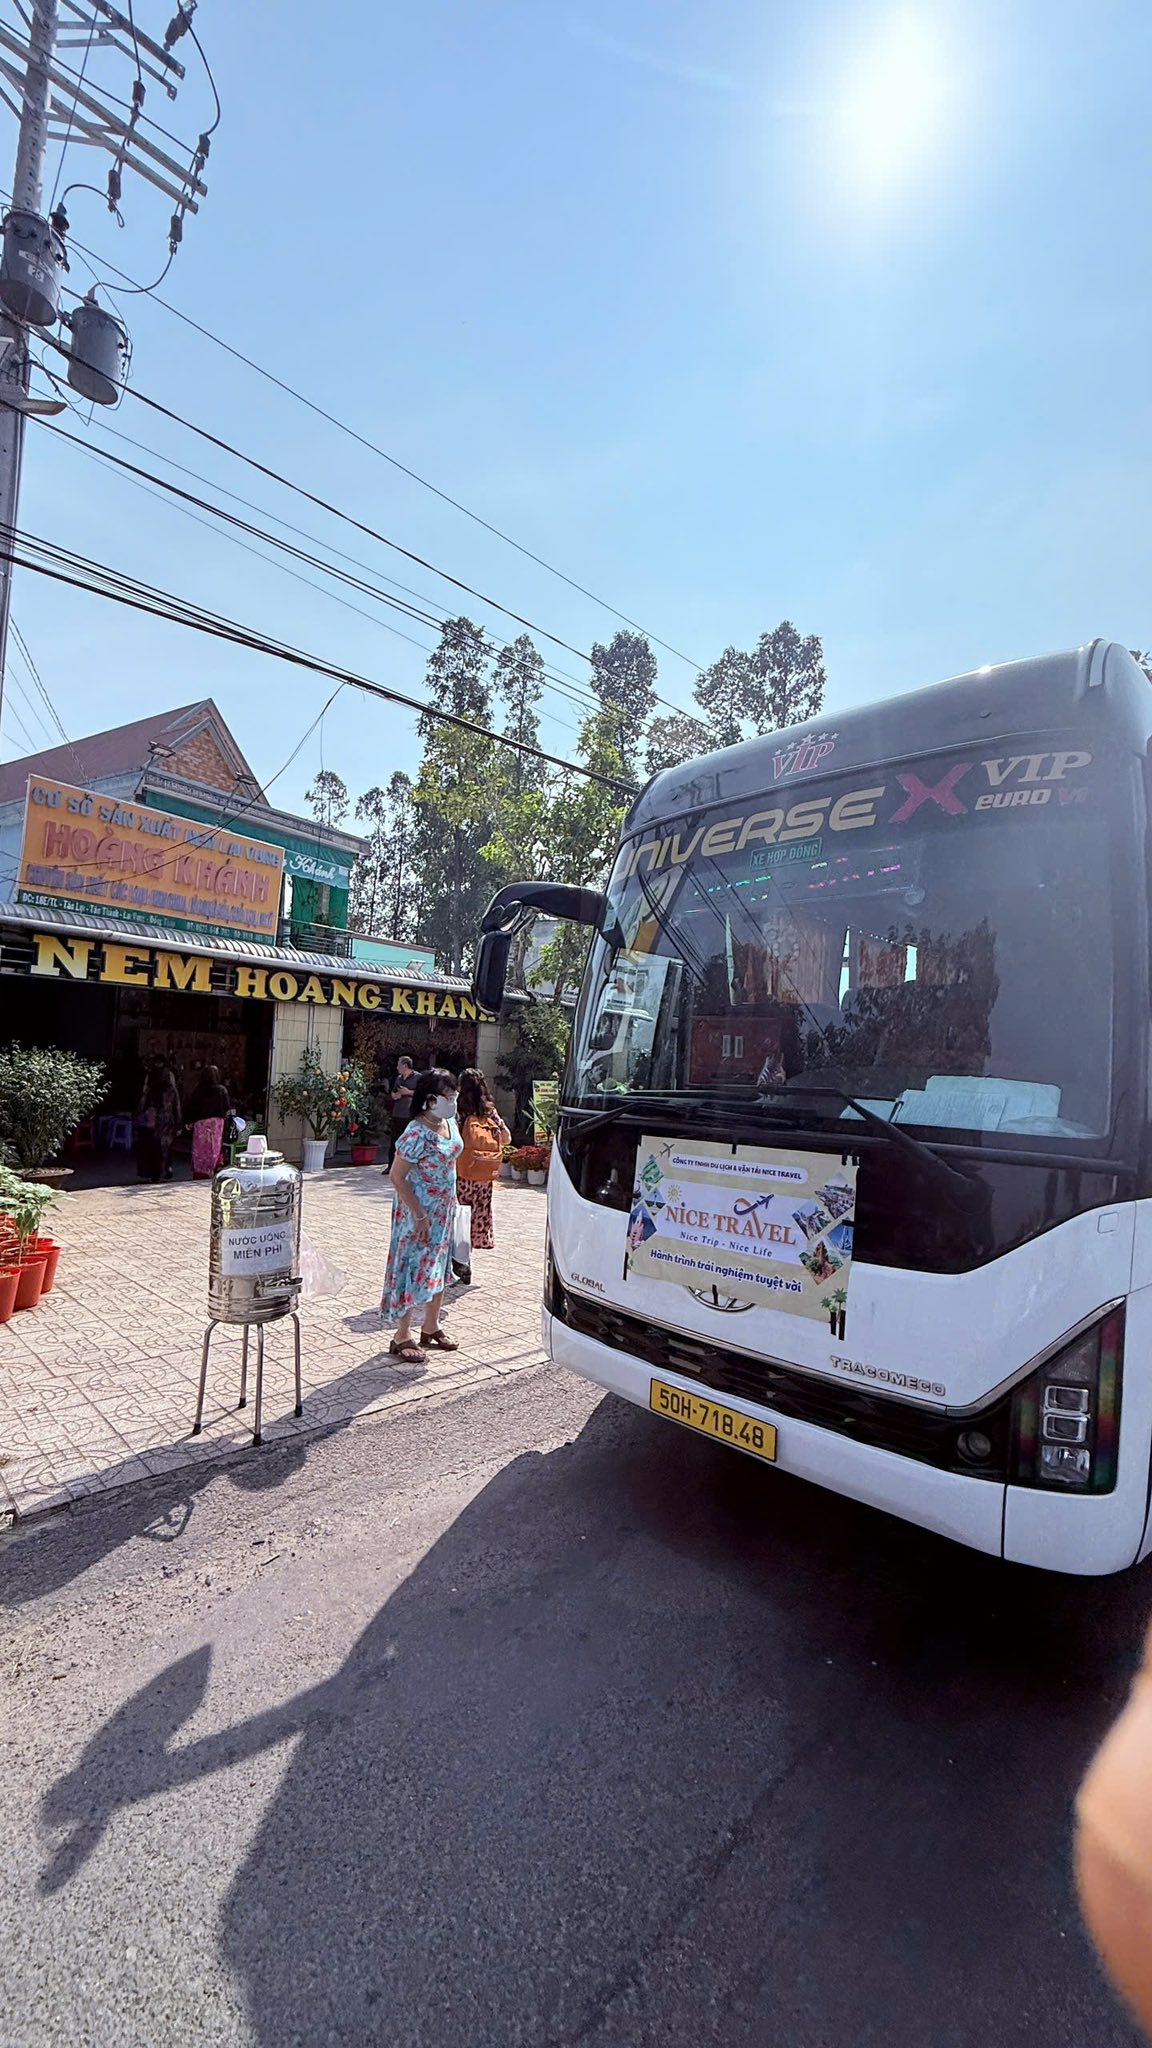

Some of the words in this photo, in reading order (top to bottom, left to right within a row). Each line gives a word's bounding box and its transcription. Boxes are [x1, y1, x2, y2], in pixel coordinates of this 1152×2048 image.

[772, 741, 835, 780] VIP
[981, 751, 1093, 786] VIP
[888, 762, 975, 823] X
[67, 793, 94, 817] SỞ
[184, 829, 217, 851] NEM
[219, 840, 243, 858] LAI
[246, 846, 281, 868] VUNG
[174, 856, 270, 902] KHÁNH
[289, 855, 336, 880] Khánh
[752, 853, 765, 867] XE
[30, 934, 214, 992] NEM
[672, 1156, 687, 1165] CÔNG
[719, 1163, 732, 1171] LỊCH
[761, 1168, 776, 1177] NICE
[777, 1170, 802, 1180] TRAVEL
[228, 1235, 257, 1246] NƯỚC
[665, 1202, 710, 1229] NICE
[713, 1206, 797, 1246] TRAVEL
[680, 1231, 699, 1242] Nice
[702, 1235, 719, 1248] Trip
[729, 1241, 749, 1253] Nice
[753, 1246, 773, 1257] Life
[570, 1272, 606, 1293] GLOBAL
[650, 1249, 673, 1262] Hành
[674, 1254, 696, 1268] trình
[715, 1264, 754, 1281] nghiệm
[755, 1274, 783, 1290] tuyệt
[785, 1279, 802, 1293] vời
[830, 1355, 946, 1397] TRACOMECO
[660, 1387, 764, 1449] 50H-718.48
